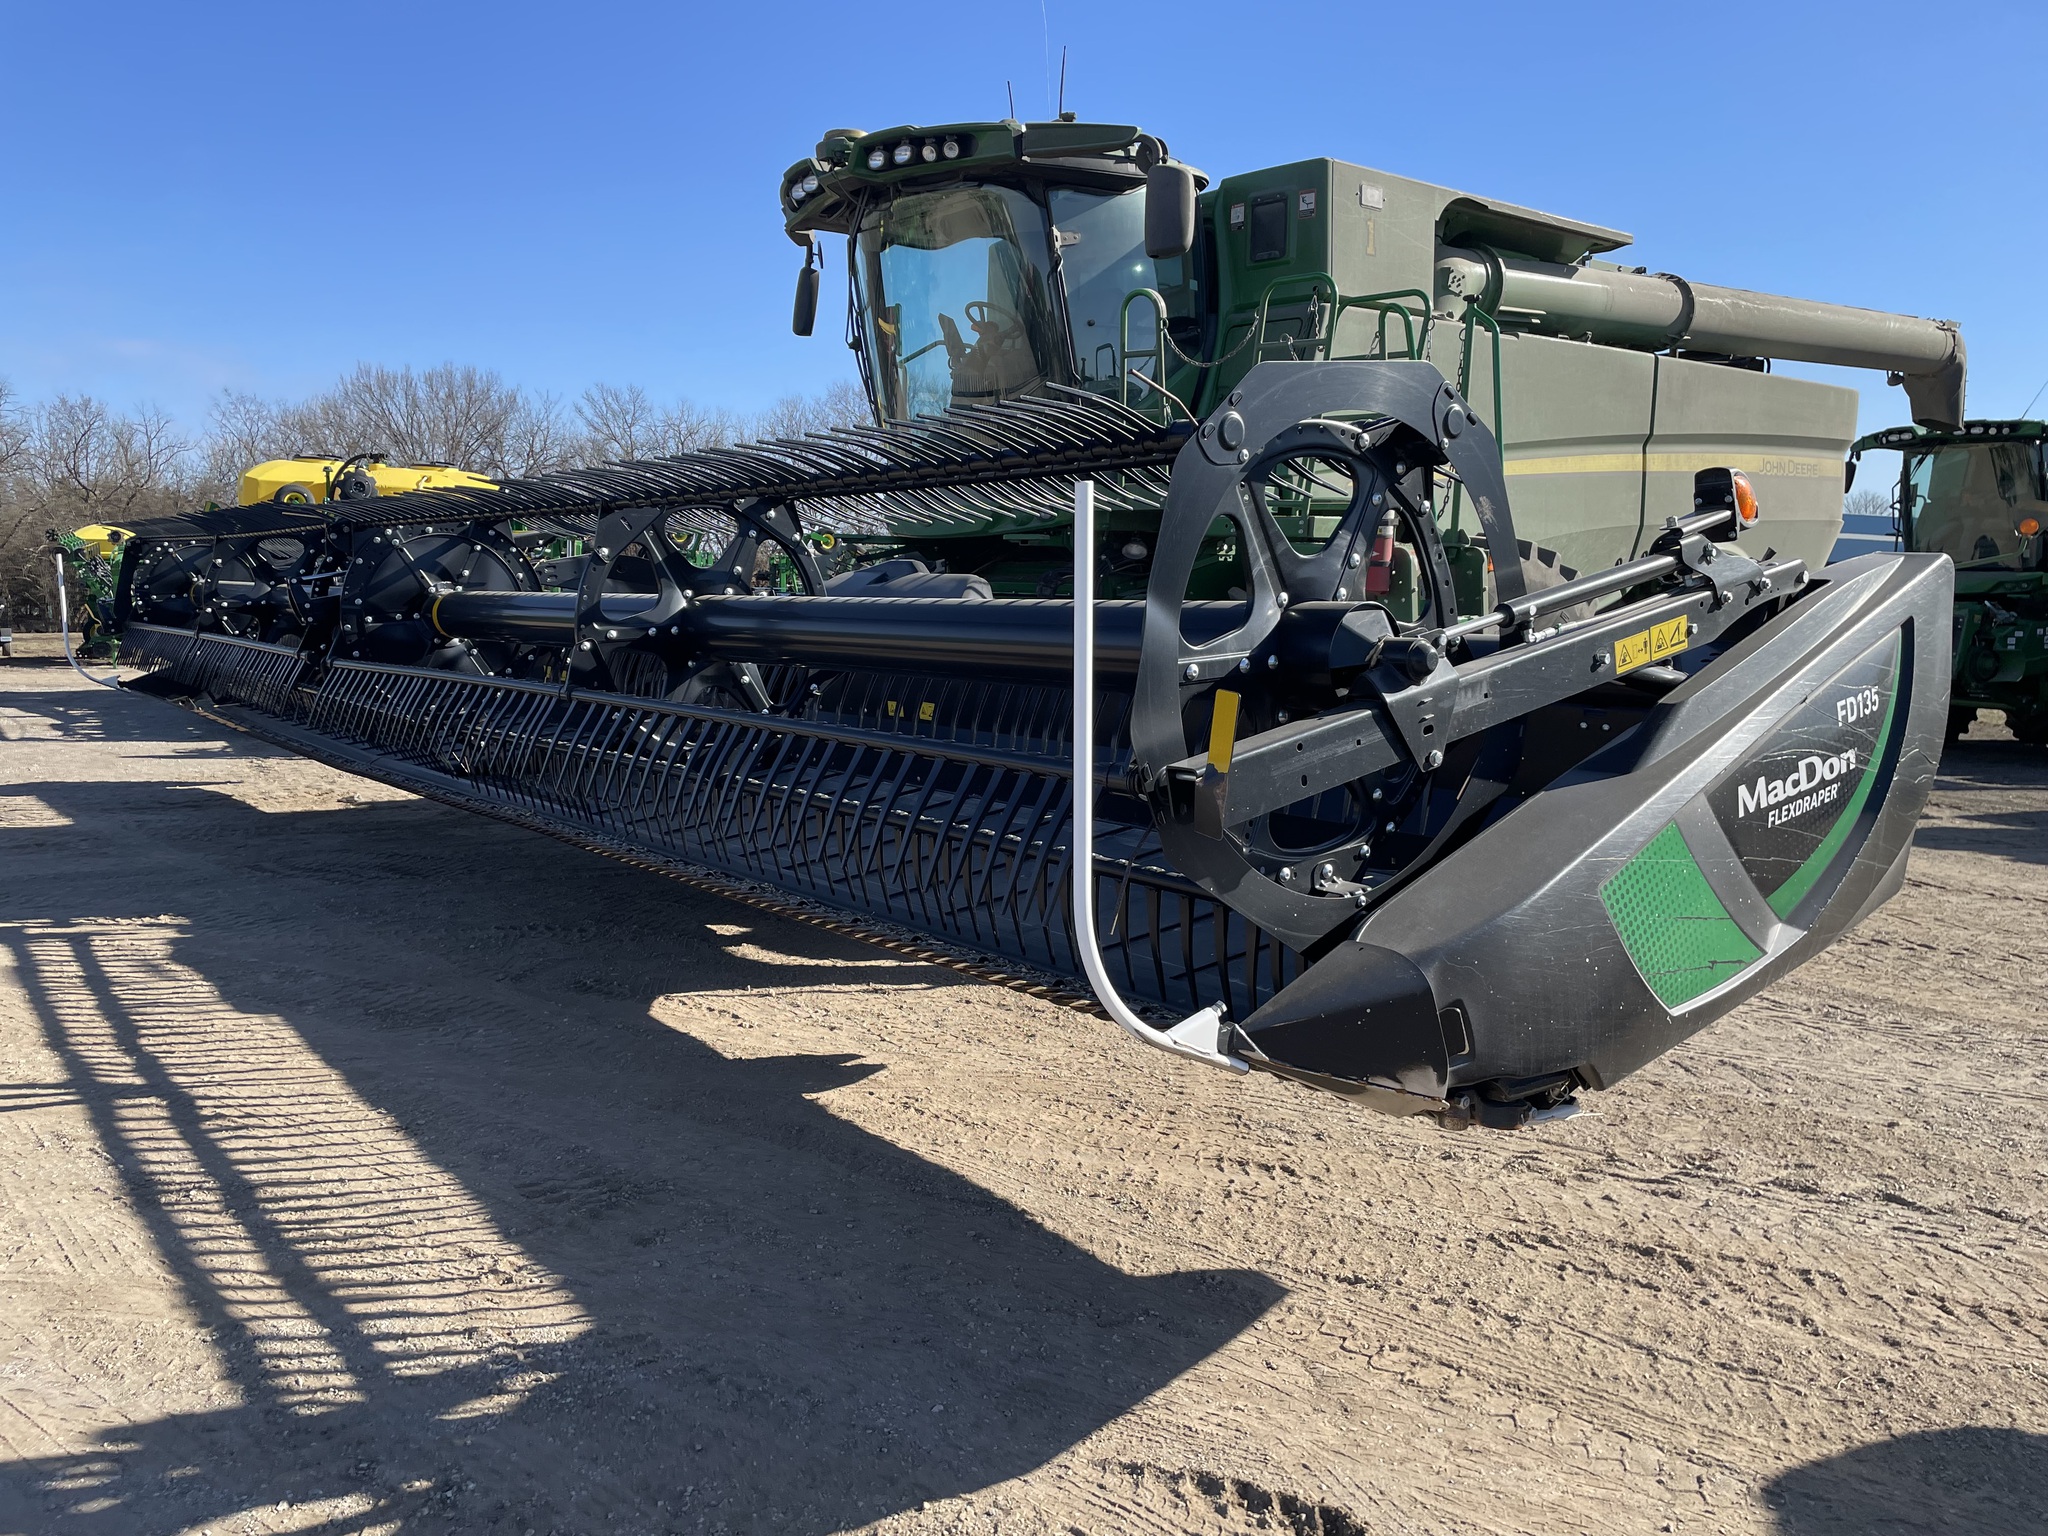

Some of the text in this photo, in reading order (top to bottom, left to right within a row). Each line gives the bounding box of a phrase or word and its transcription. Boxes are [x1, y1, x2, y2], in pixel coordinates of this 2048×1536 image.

[1759, 458, 1818, 476] JOHN DEERE
[1836, 686, 1880, 727] FD135
[1738, 748, 1857, 818] MacDon
[1768, 784, 1838, 829] FLEXDRAPER
